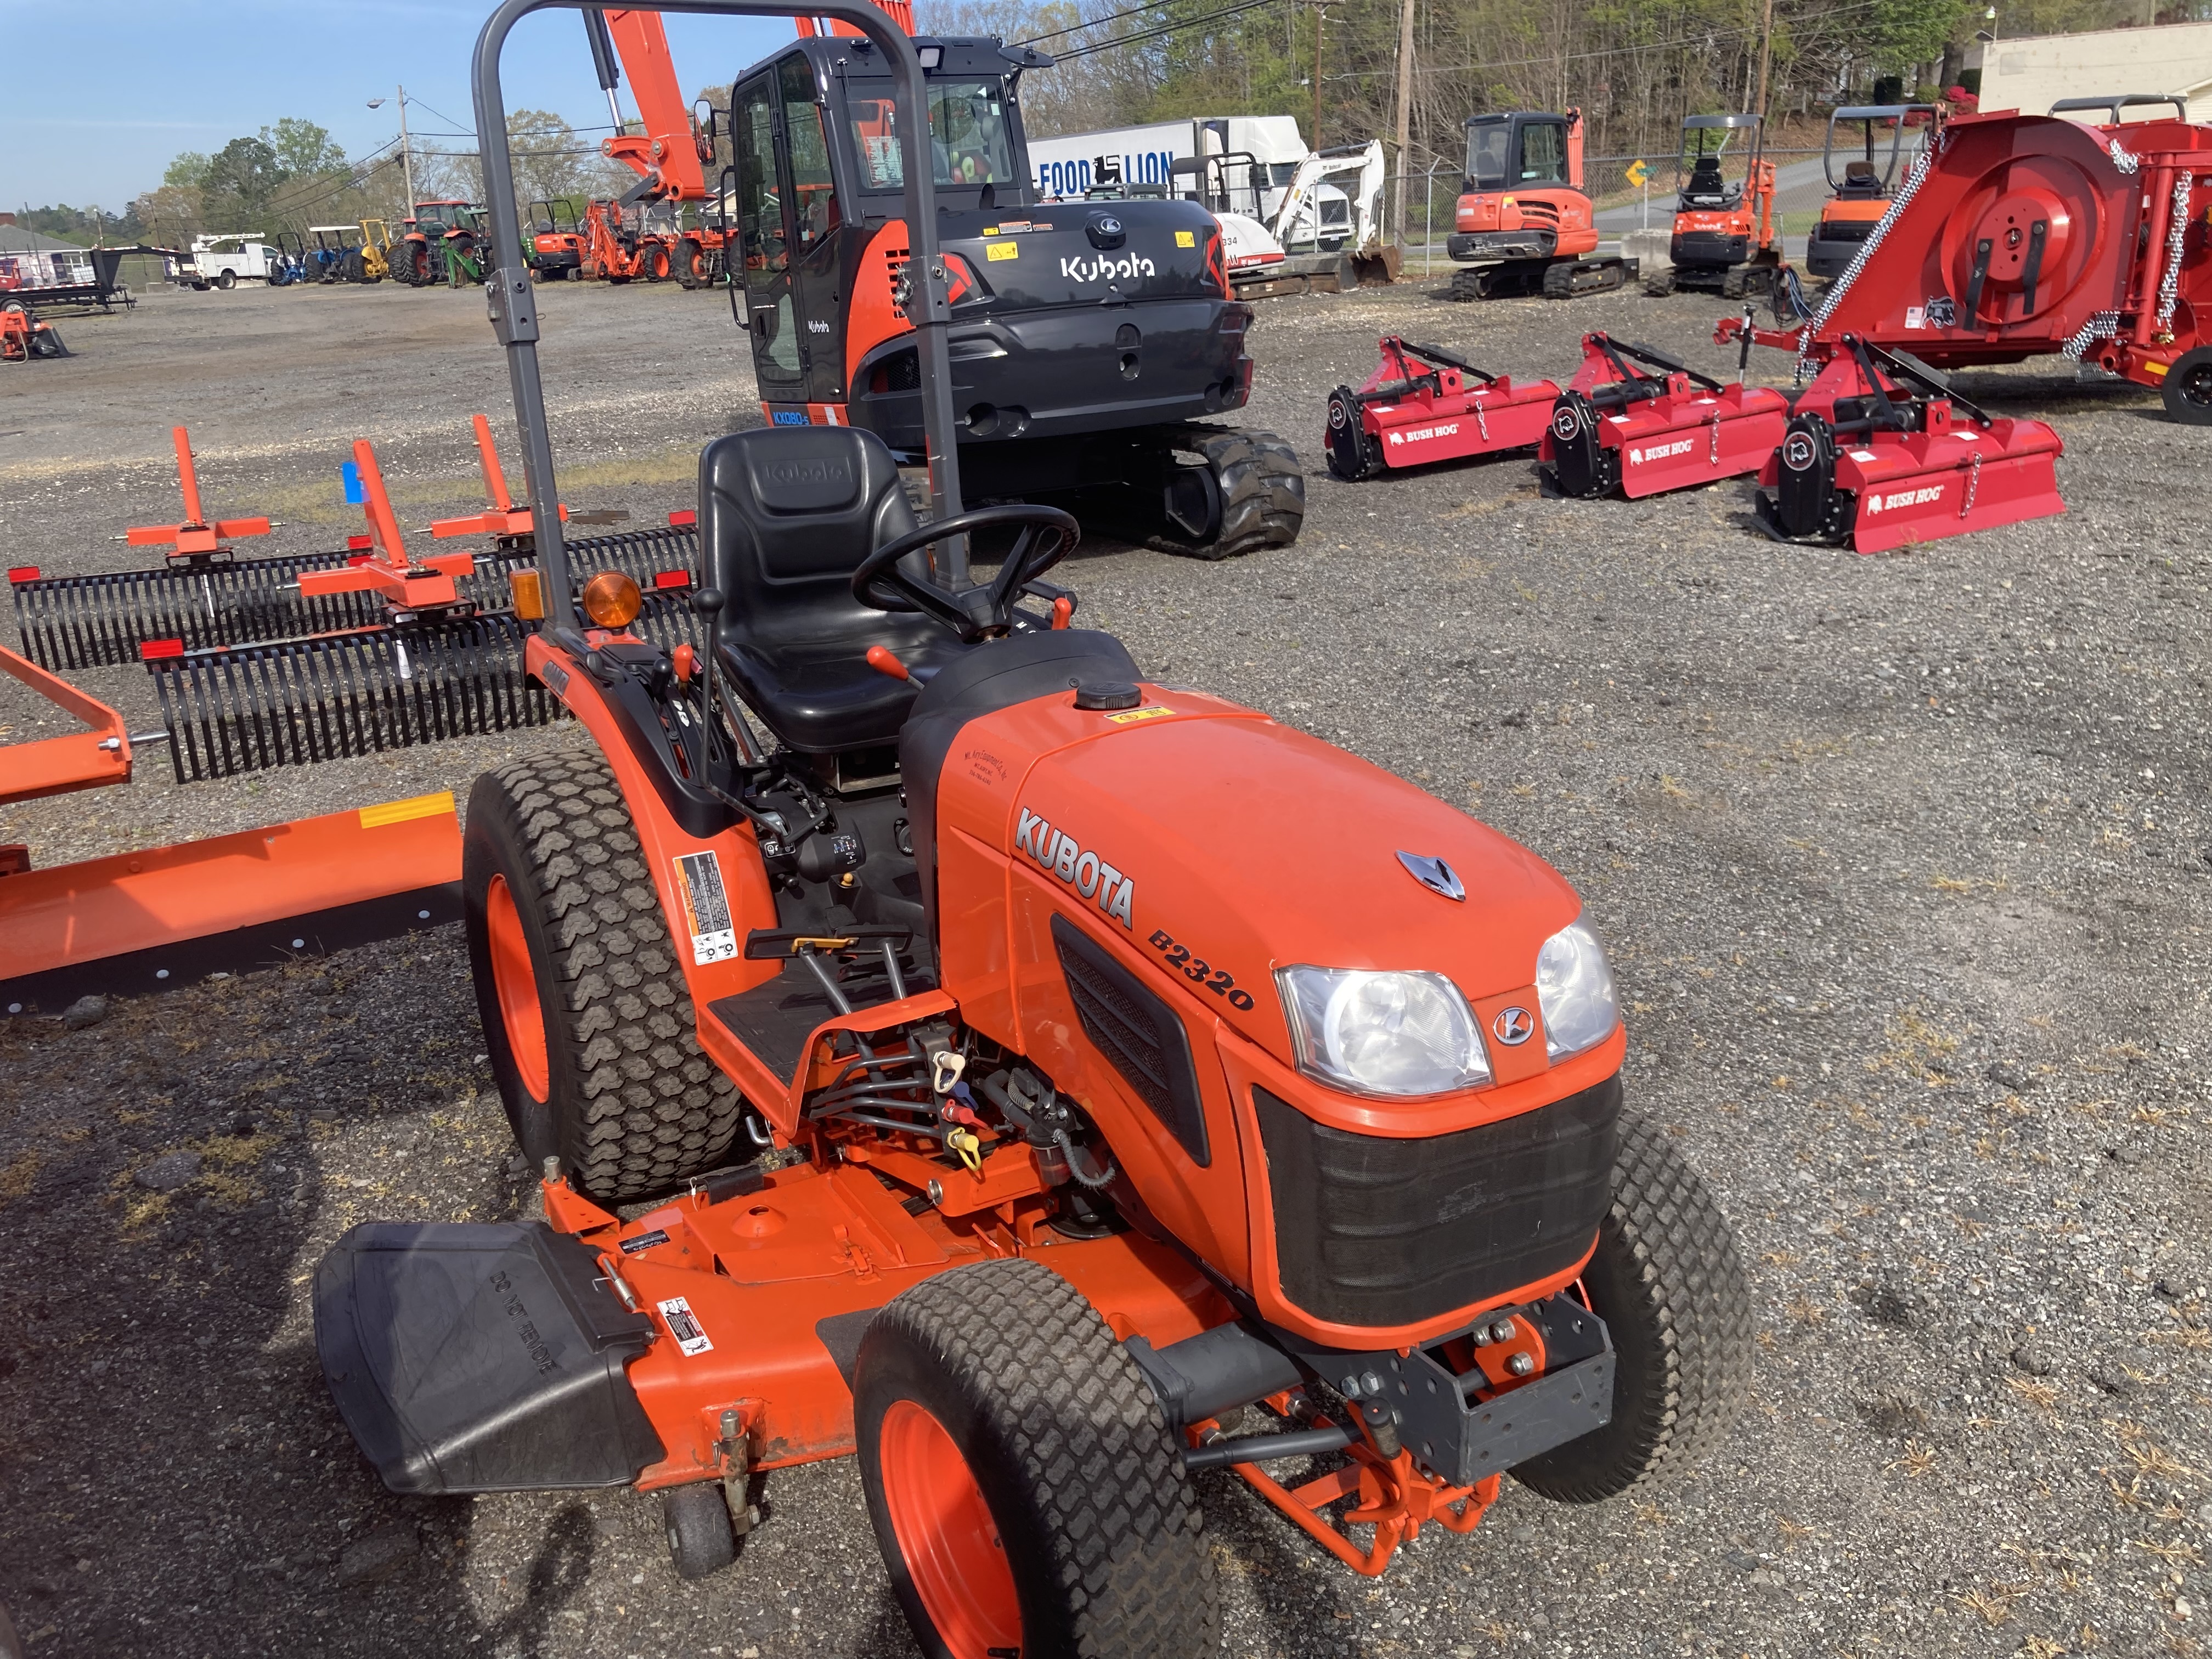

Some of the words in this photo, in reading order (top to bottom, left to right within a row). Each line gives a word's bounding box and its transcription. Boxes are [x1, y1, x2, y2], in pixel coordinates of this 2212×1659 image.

[1040, 160, 1091, 196] FOOD
[1125, 151, 1173, 184] LION
[1060, 252, 1155, 283] Kubota
[808, 320, 829, 333] Kubota
[773, 411, 809, 425] KX080-5
[1406, 428, 1434, 442] BUSH
[1435, 424, 1458, 437] HOG
[1645, 444, 1670, 461] BUSH
[1671, 439, 1691, 455] HOG
[766, 461, 843, 484] Kubota
[1884, 490, 1916, 510] BUSH
[1915, 486, 1941, 504] HOG
[1015, 806, 1135, 932] KUBOTA
[682, 882, 691, 907] WARNING
[1148, 928, 1255, 1012] B2320
[490, 1271, 511, 1293] DO
[503, 1294, 528, 1322] NOT
[517, 1320, 558, 1378] REMOVE
